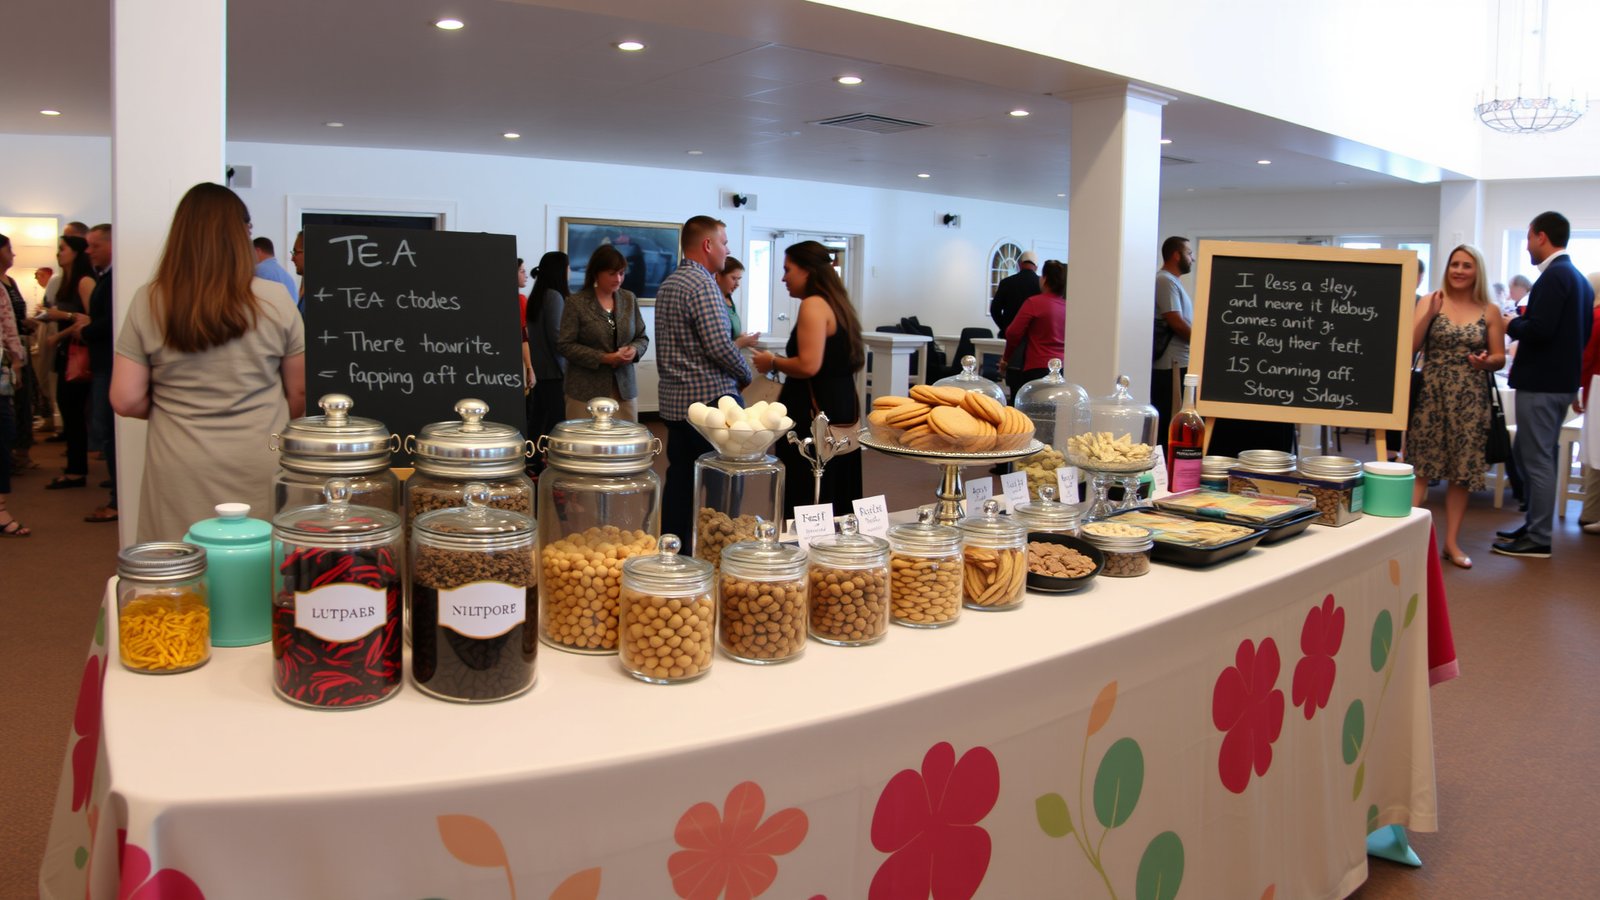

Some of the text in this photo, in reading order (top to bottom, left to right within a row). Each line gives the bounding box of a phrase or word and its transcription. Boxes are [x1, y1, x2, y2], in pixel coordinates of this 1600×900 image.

[1302, 280, 1313, 292] a
[337, 287, 384, 308] TEA
[1229, 294, 1258, 308] and
[1311, 298, 1322, 312] it
[1282, 316, 1316, 330] anit
[344, 331, 406, 352] There
[349, 362, 414, 394] fapping
[422, 365, 457, 385] aft
[466, 366, 522, 388] chures
[1225, 356, 1250, 372] 15
[1256, 359, 1321, 384] Canning
